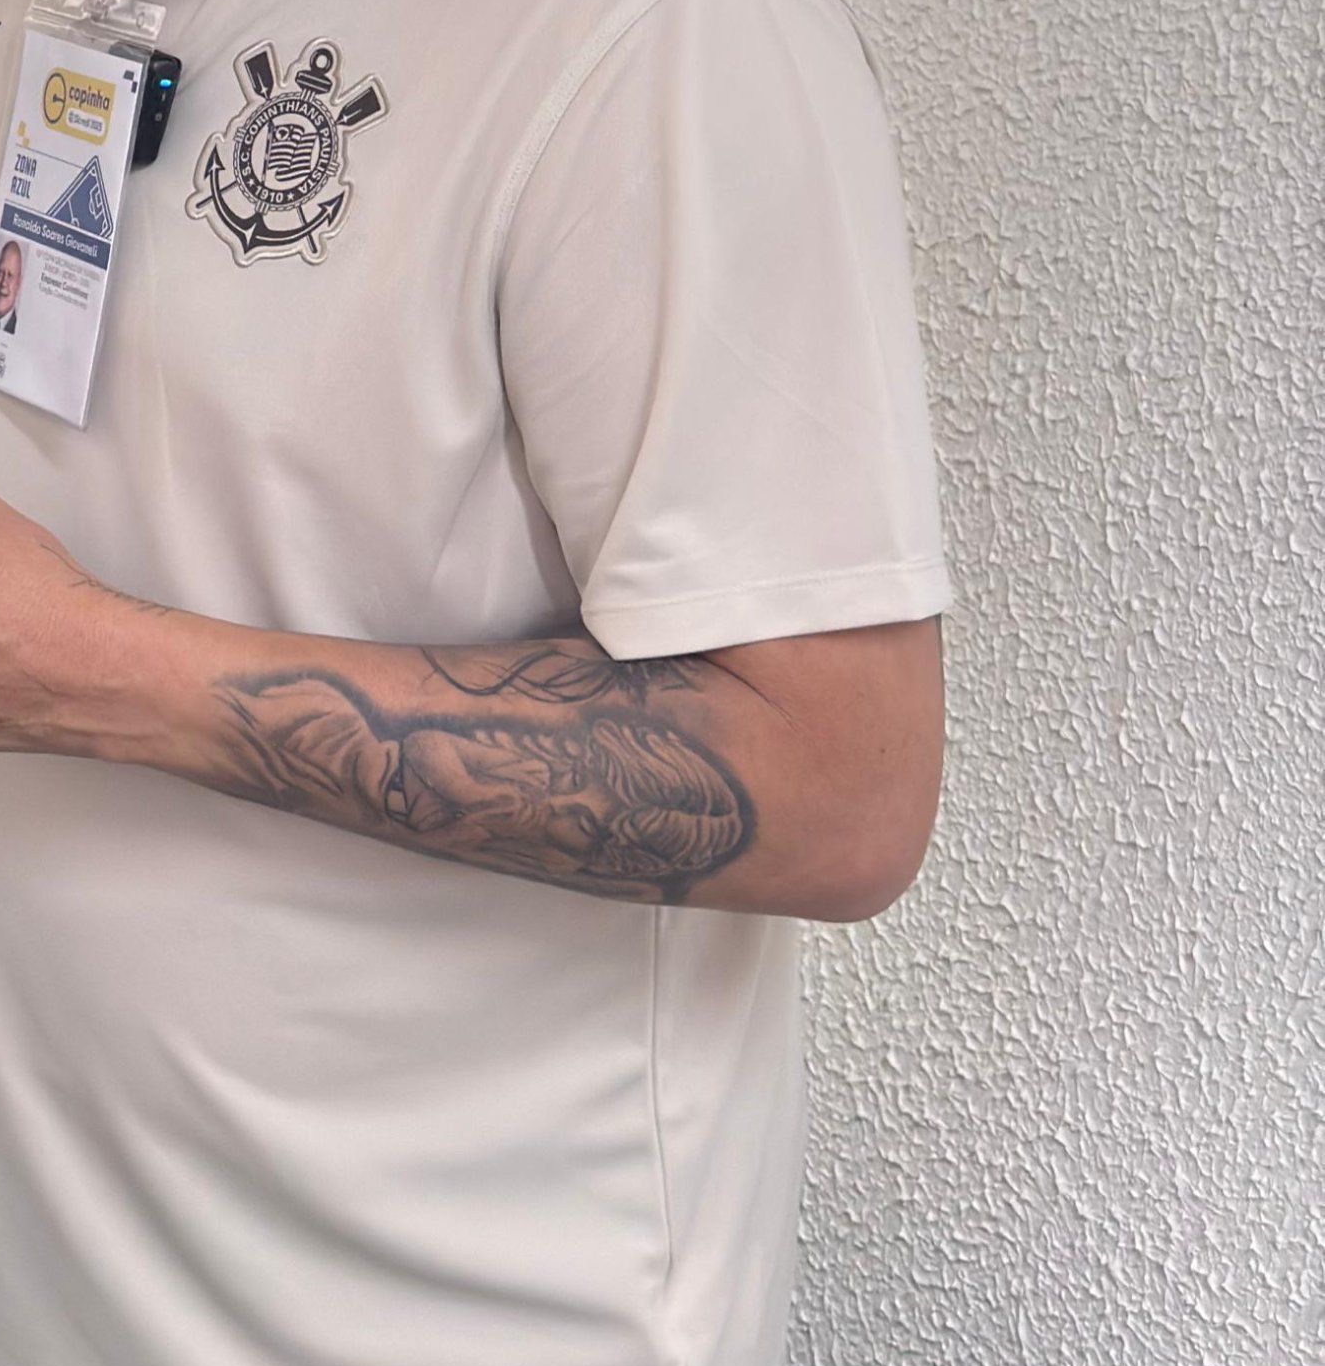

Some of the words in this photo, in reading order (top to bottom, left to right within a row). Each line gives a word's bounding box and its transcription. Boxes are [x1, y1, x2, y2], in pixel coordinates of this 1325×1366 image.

[69, 85, 110, 110] copinha
[244, 101, 324, 144] CORINTHIANS
[299, 126, 330, 195] PAULISTA
[14, 154, 37, 178] ZONA
[10, 175, 31, 199] AZUL
[254, 186, 283, 204] 1910
[12, 213, 41, 235] Ronaldo
[42, 224, 64, 245] Soares
